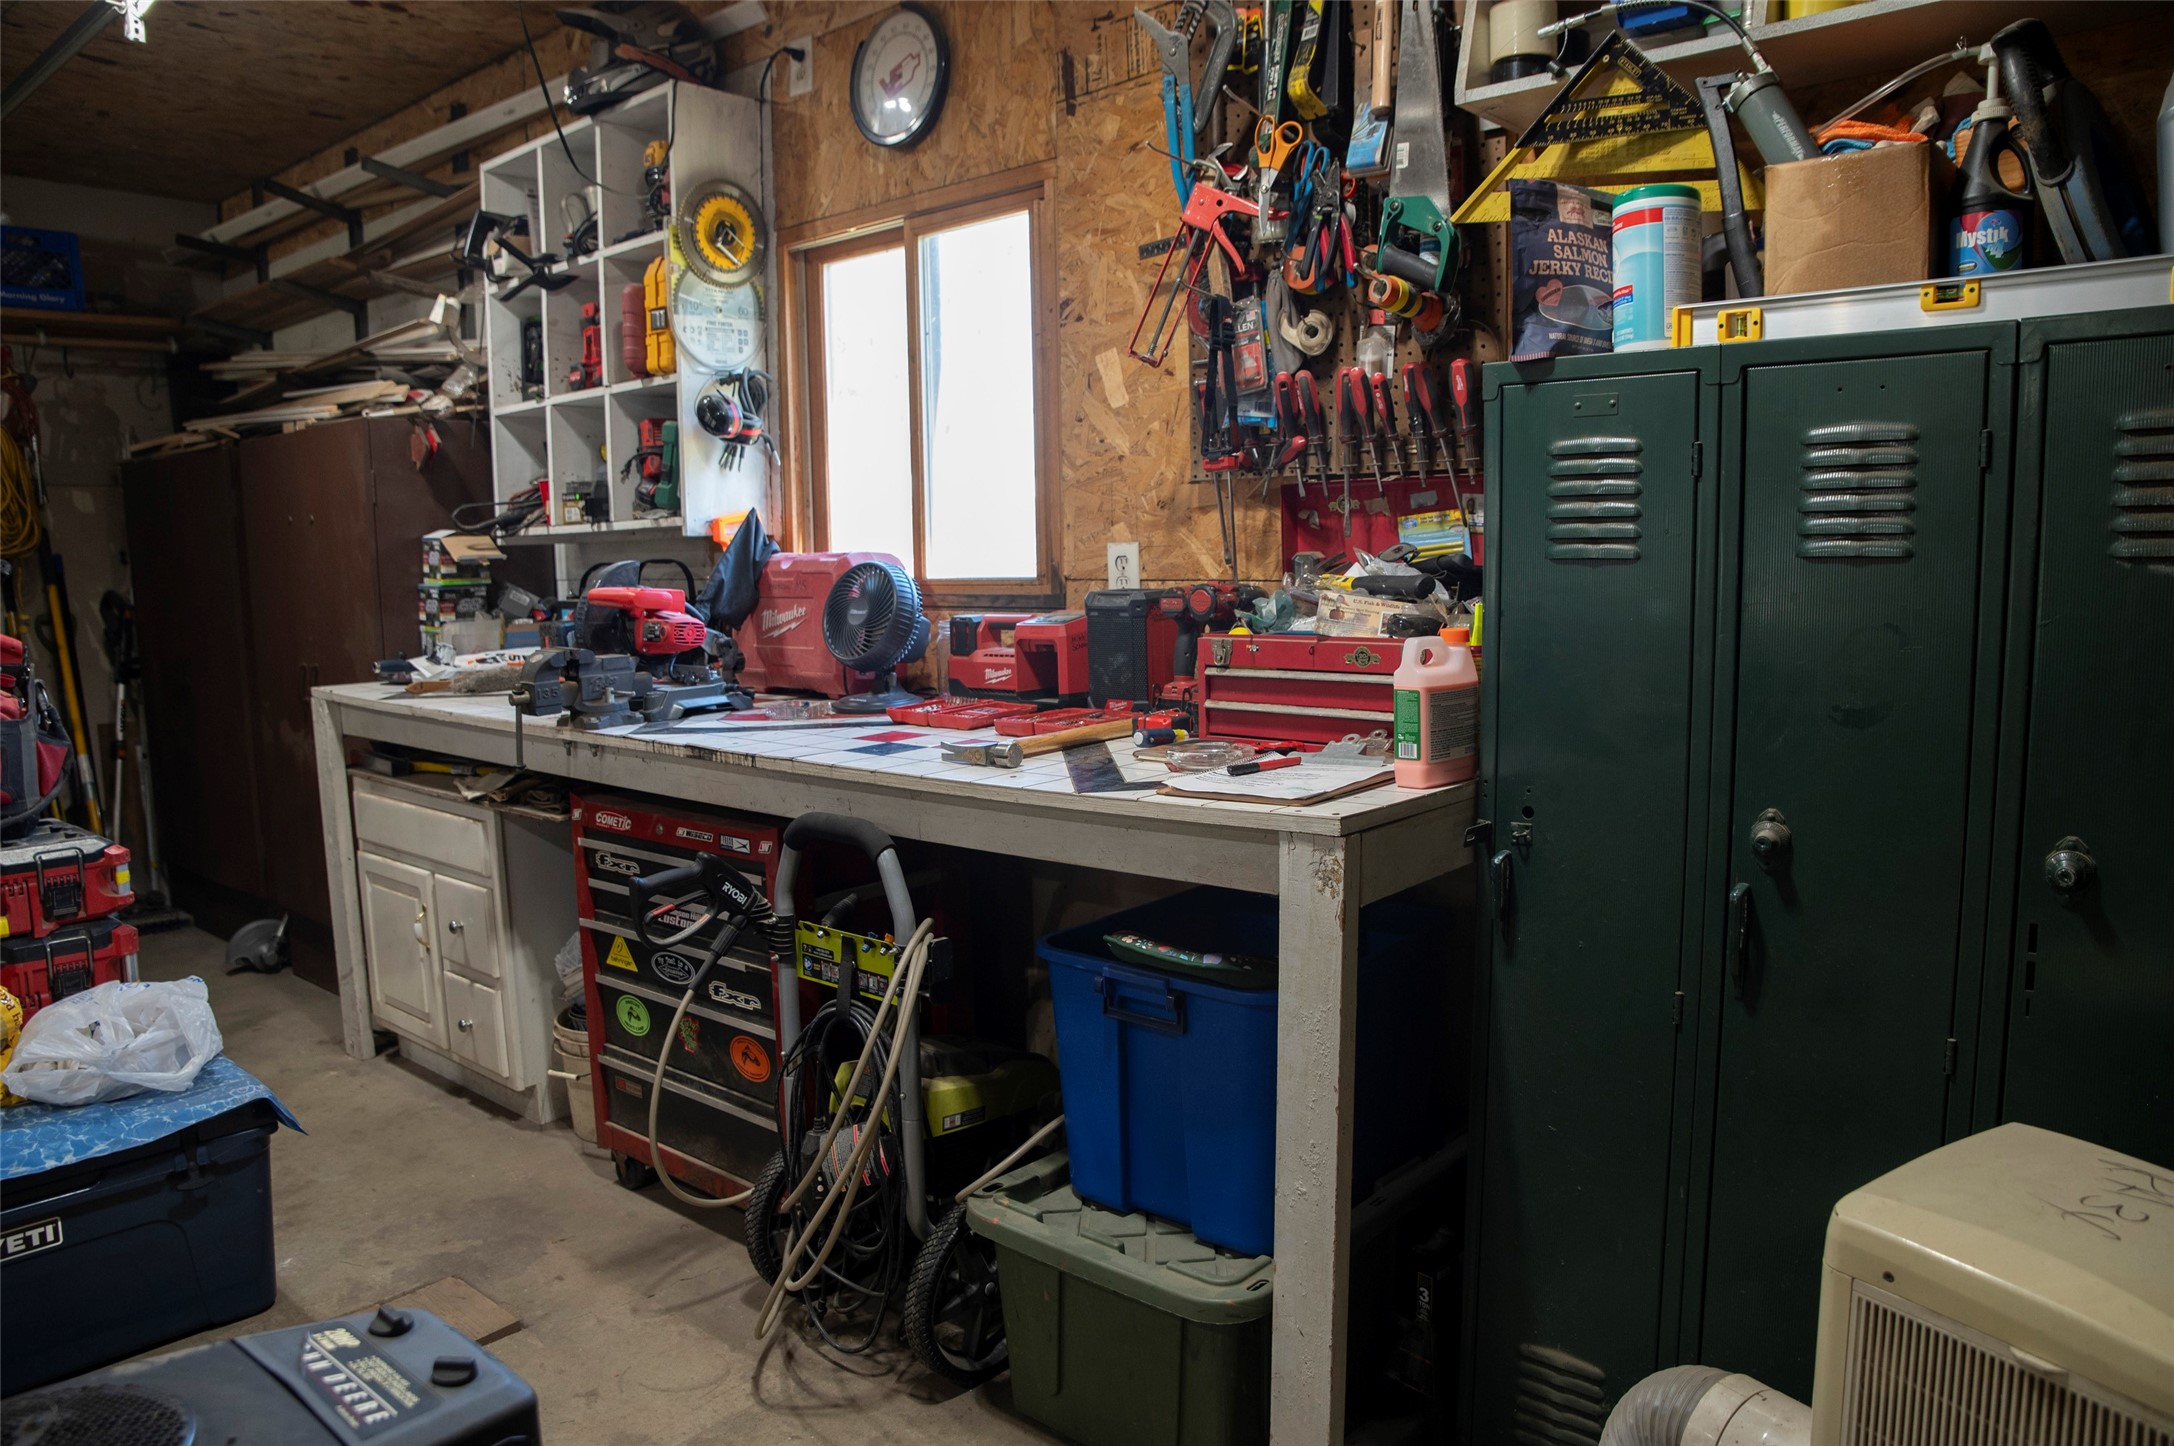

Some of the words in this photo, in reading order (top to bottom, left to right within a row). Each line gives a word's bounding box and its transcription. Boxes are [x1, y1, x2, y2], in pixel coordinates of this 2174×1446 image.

[1547, 228, 1608, 253] ALASKAN
[1956, 226, 2009, 249] Mystik
[1553, 244, 1608, 267] SALMON
[1528, 259, 1581, 276] JERKY
[1584, 263, 1614, 284] RECI
[762, 604, 806, 631] Milwaukee
[985, 667, 1012, 679] Milwaukee
[537, 686, 559, 699] 135
[595, 812, 632, 830] COMETIC
[596, 851, 640, 874] fxr
[722, 882, 747, 904] RYOBI
[709, 981, 762, 1011] fxr
[0, 1224, 55, 1254] ETI
[1419, 1287, 1429, 1303] 3
[322, 1372, 389, 1425] DEERE
